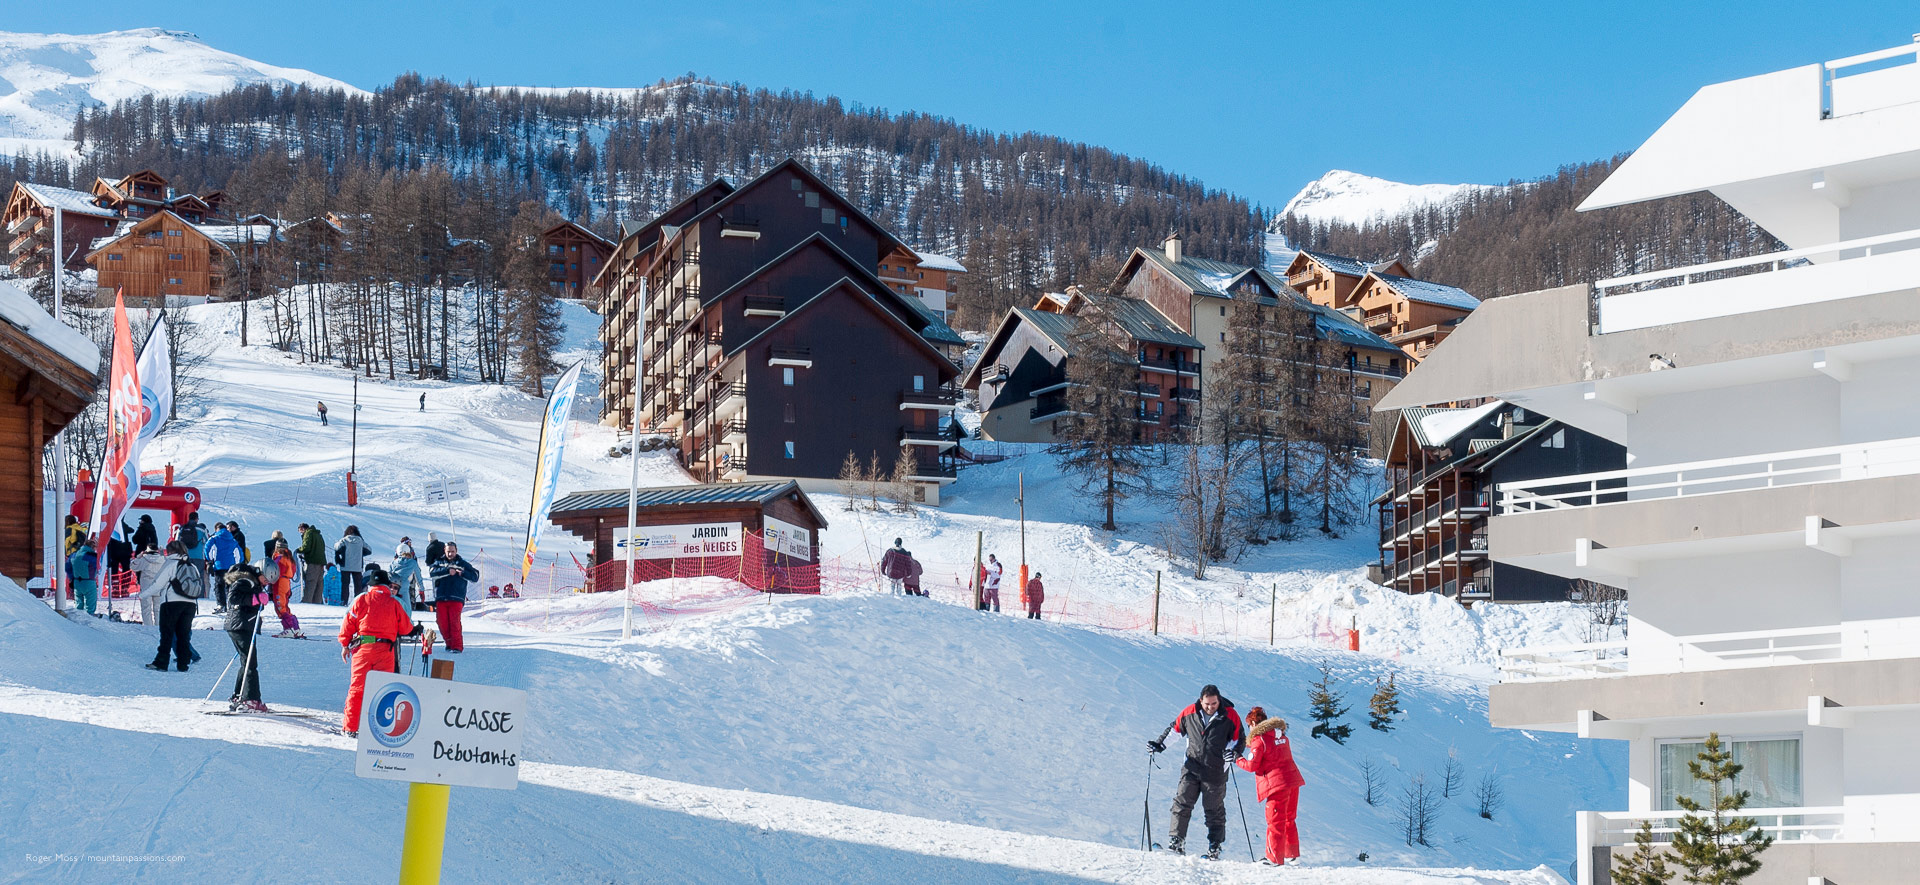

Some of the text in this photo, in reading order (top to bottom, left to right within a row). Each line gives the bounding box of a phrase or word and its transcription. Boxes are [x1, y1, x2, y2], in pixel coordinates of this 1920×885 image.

[138, 490, 163, 500] SF
[692, 526, 728, 538] JARDIN
[683, 541, 737, 553] des NEIGES
[443, 705, 514, 733] CLASSE
[433, 740, 517, 767] Débutants
